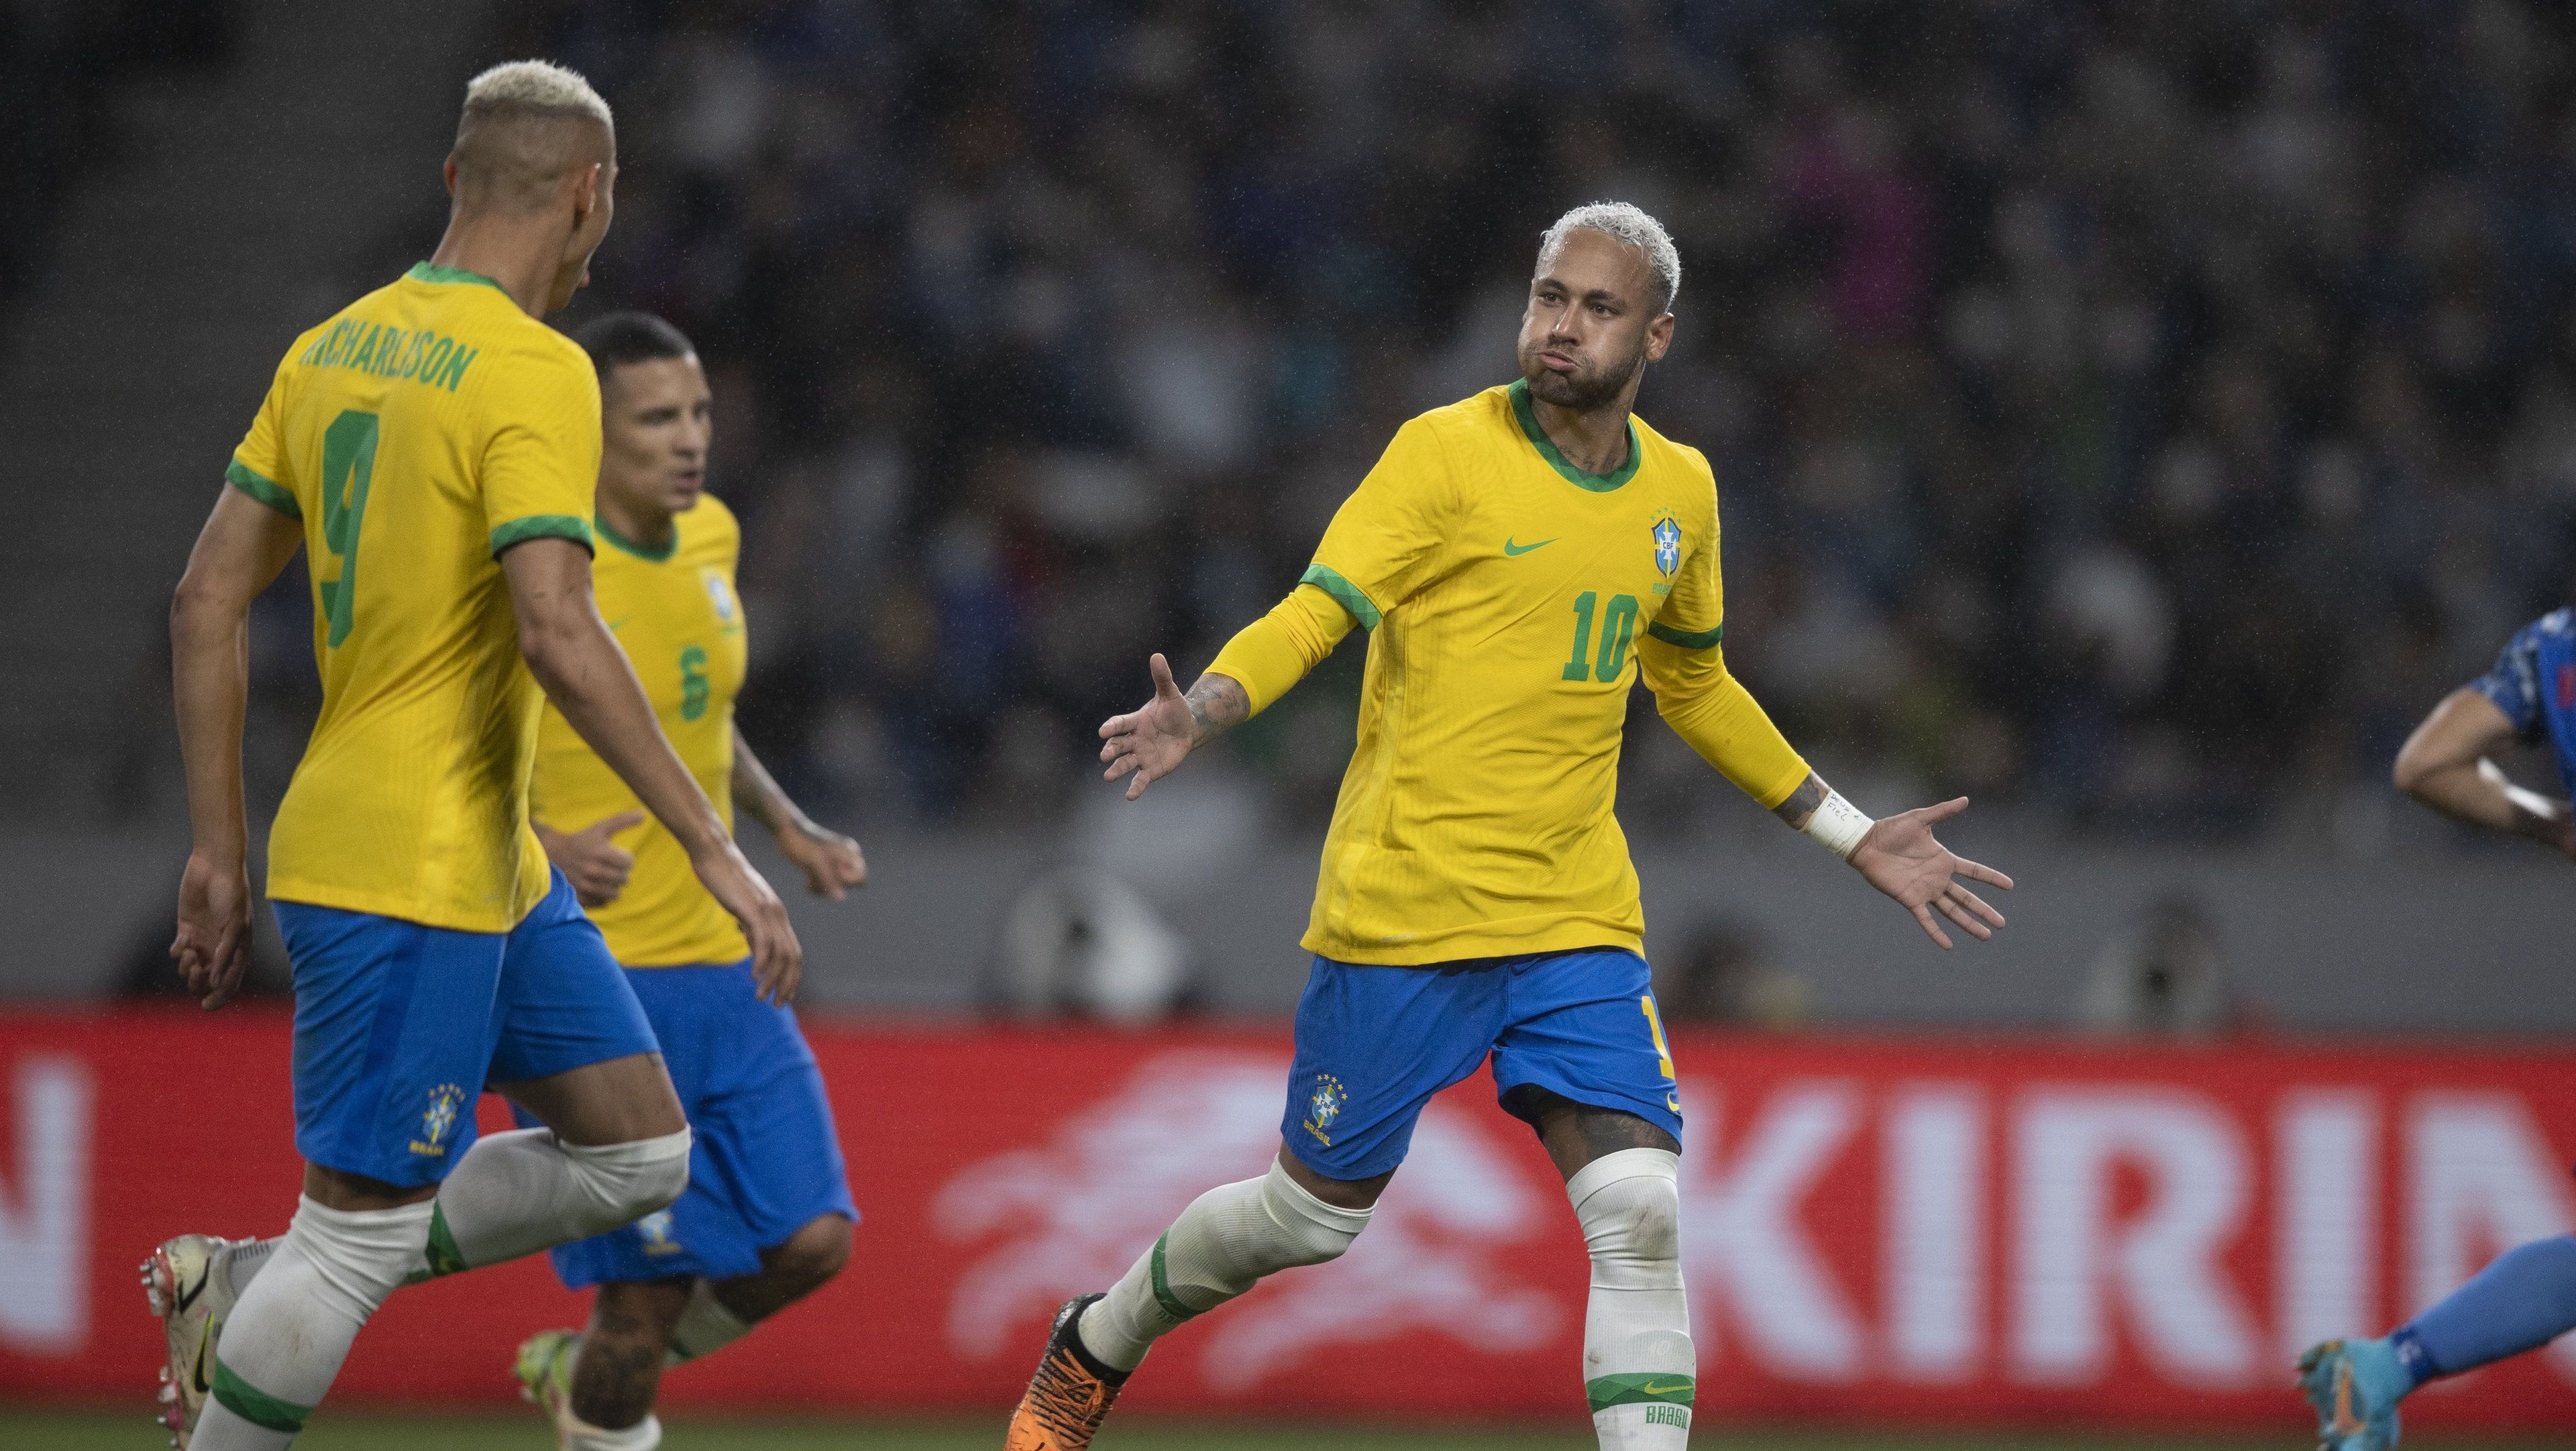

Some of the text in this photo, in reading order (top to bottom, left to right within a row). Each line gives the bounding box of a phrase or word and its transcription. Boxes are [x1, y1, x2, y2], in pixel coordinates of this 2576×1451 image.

[320, 409, 380, 649] 9
[1562, 591, 1640, 683] 10
[679, 644, 710, 722] 6
[1320, 1099, 1332, 1110] CBF
[1303, 1119, 1331, 1147] BRASIL
[1646, 1405, 1688, 1430] BRASIL
